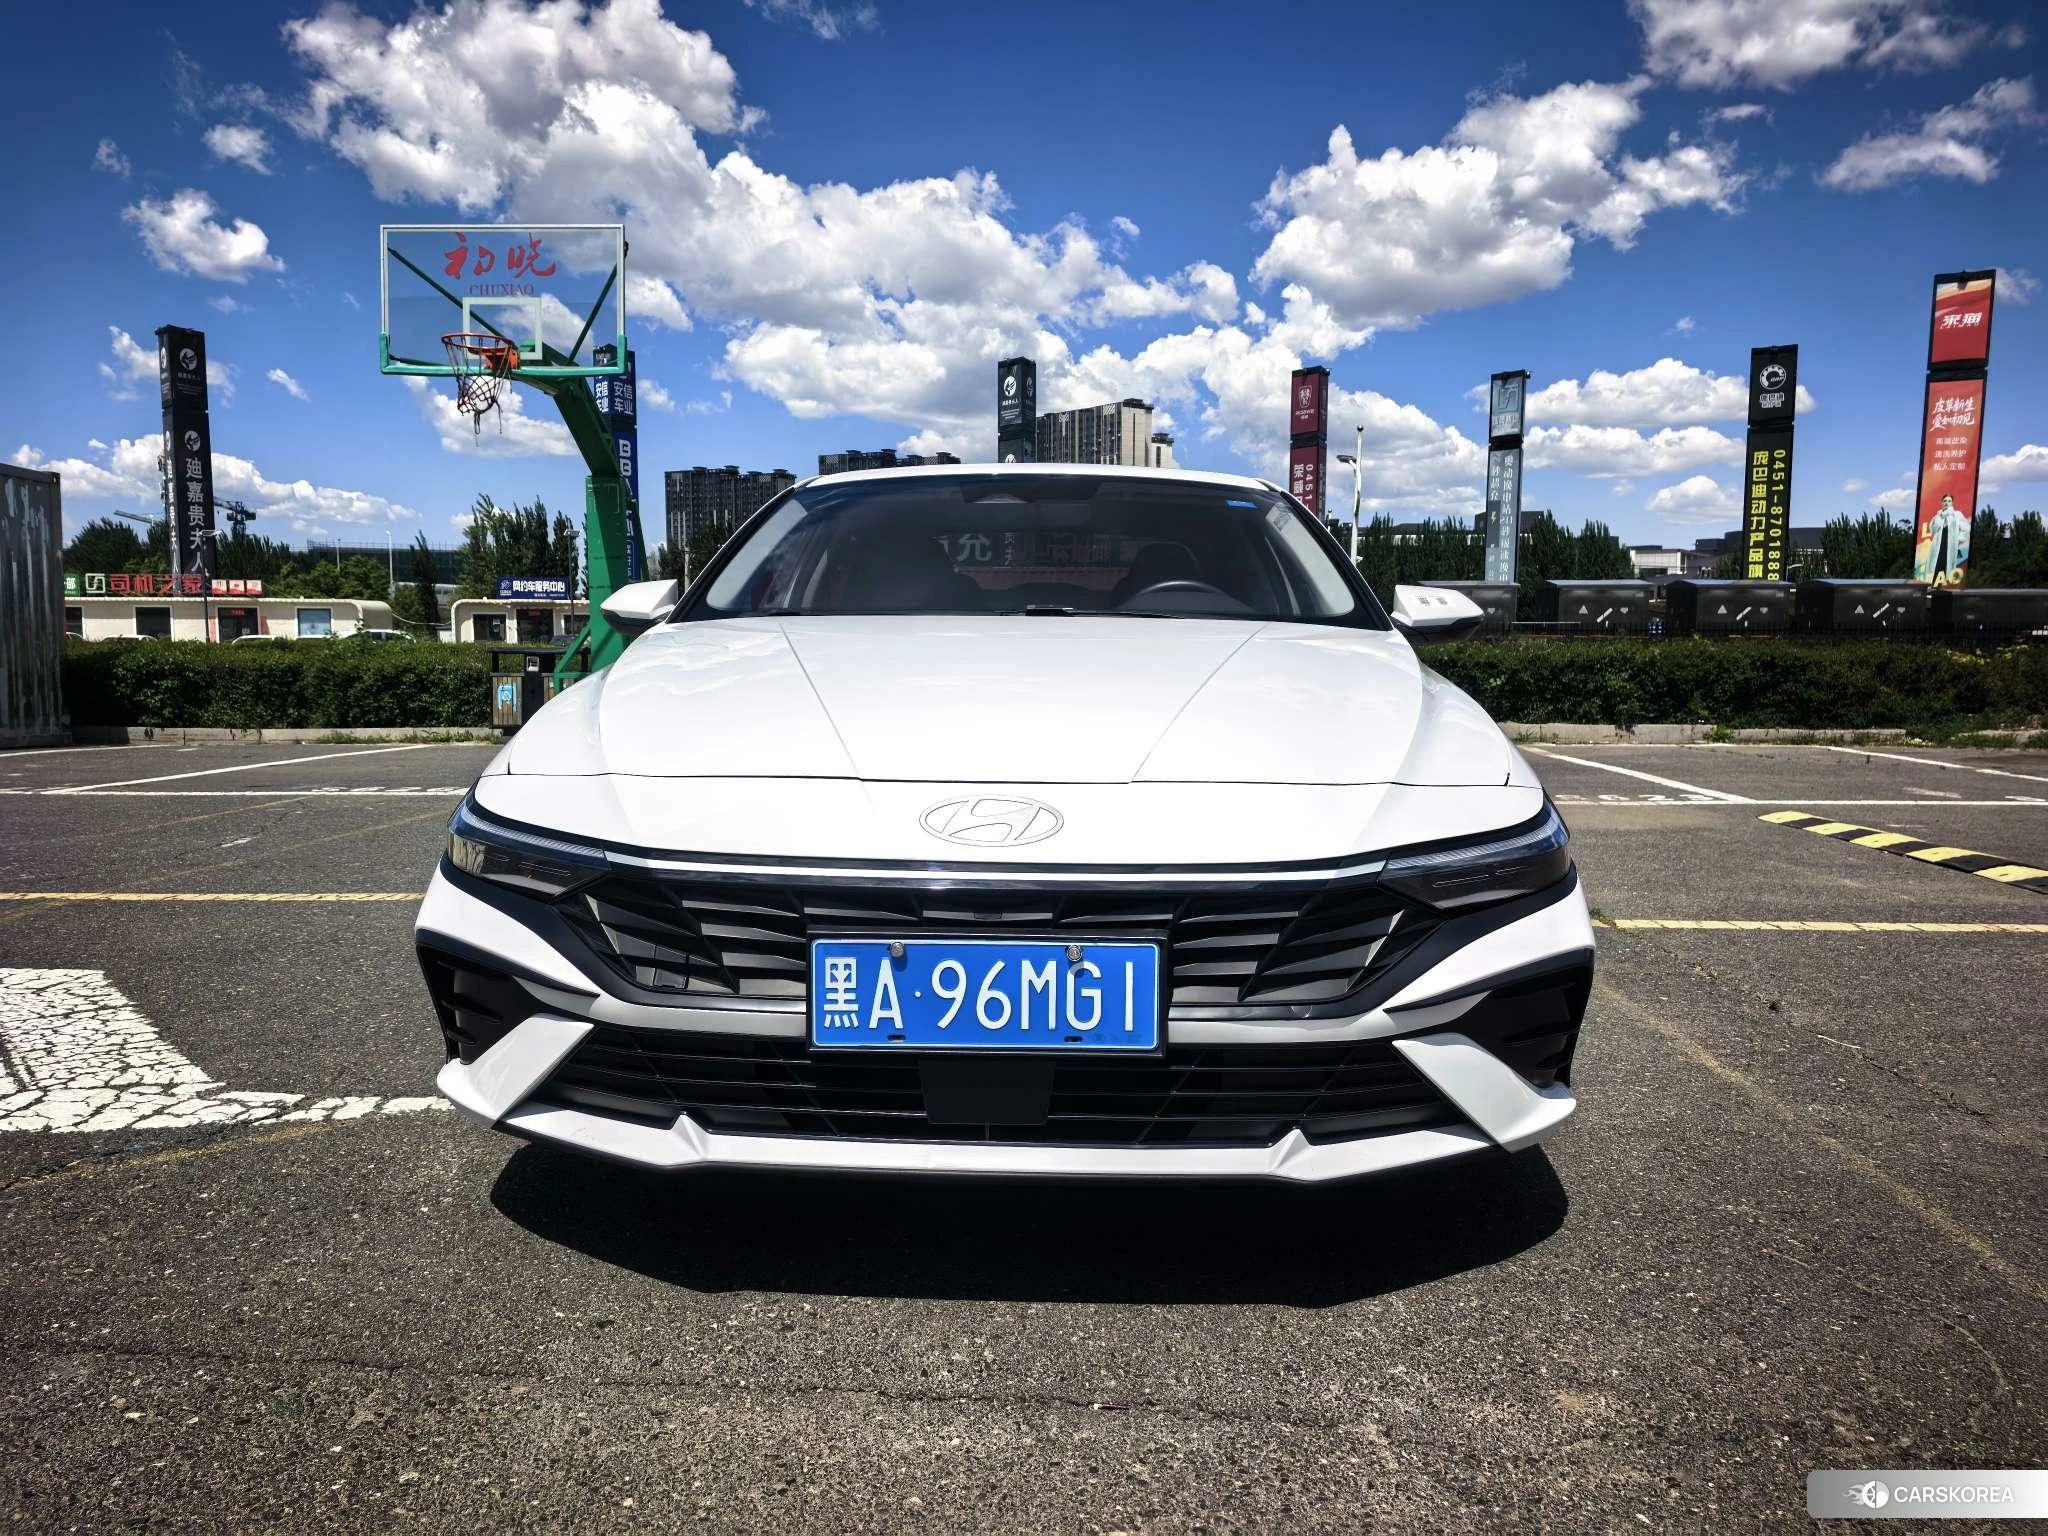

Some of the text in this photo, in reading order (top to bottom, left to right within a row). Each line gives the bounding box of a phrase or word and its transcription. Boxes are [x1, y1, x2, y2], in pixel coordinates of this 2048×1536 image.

[469, 284, 534, 297] CHUXIAO
[64, 577, 77, 590] 部
[110, 573, 203, 594] 司机之家
[512, 580, 565, 592] 网约车服务中心
